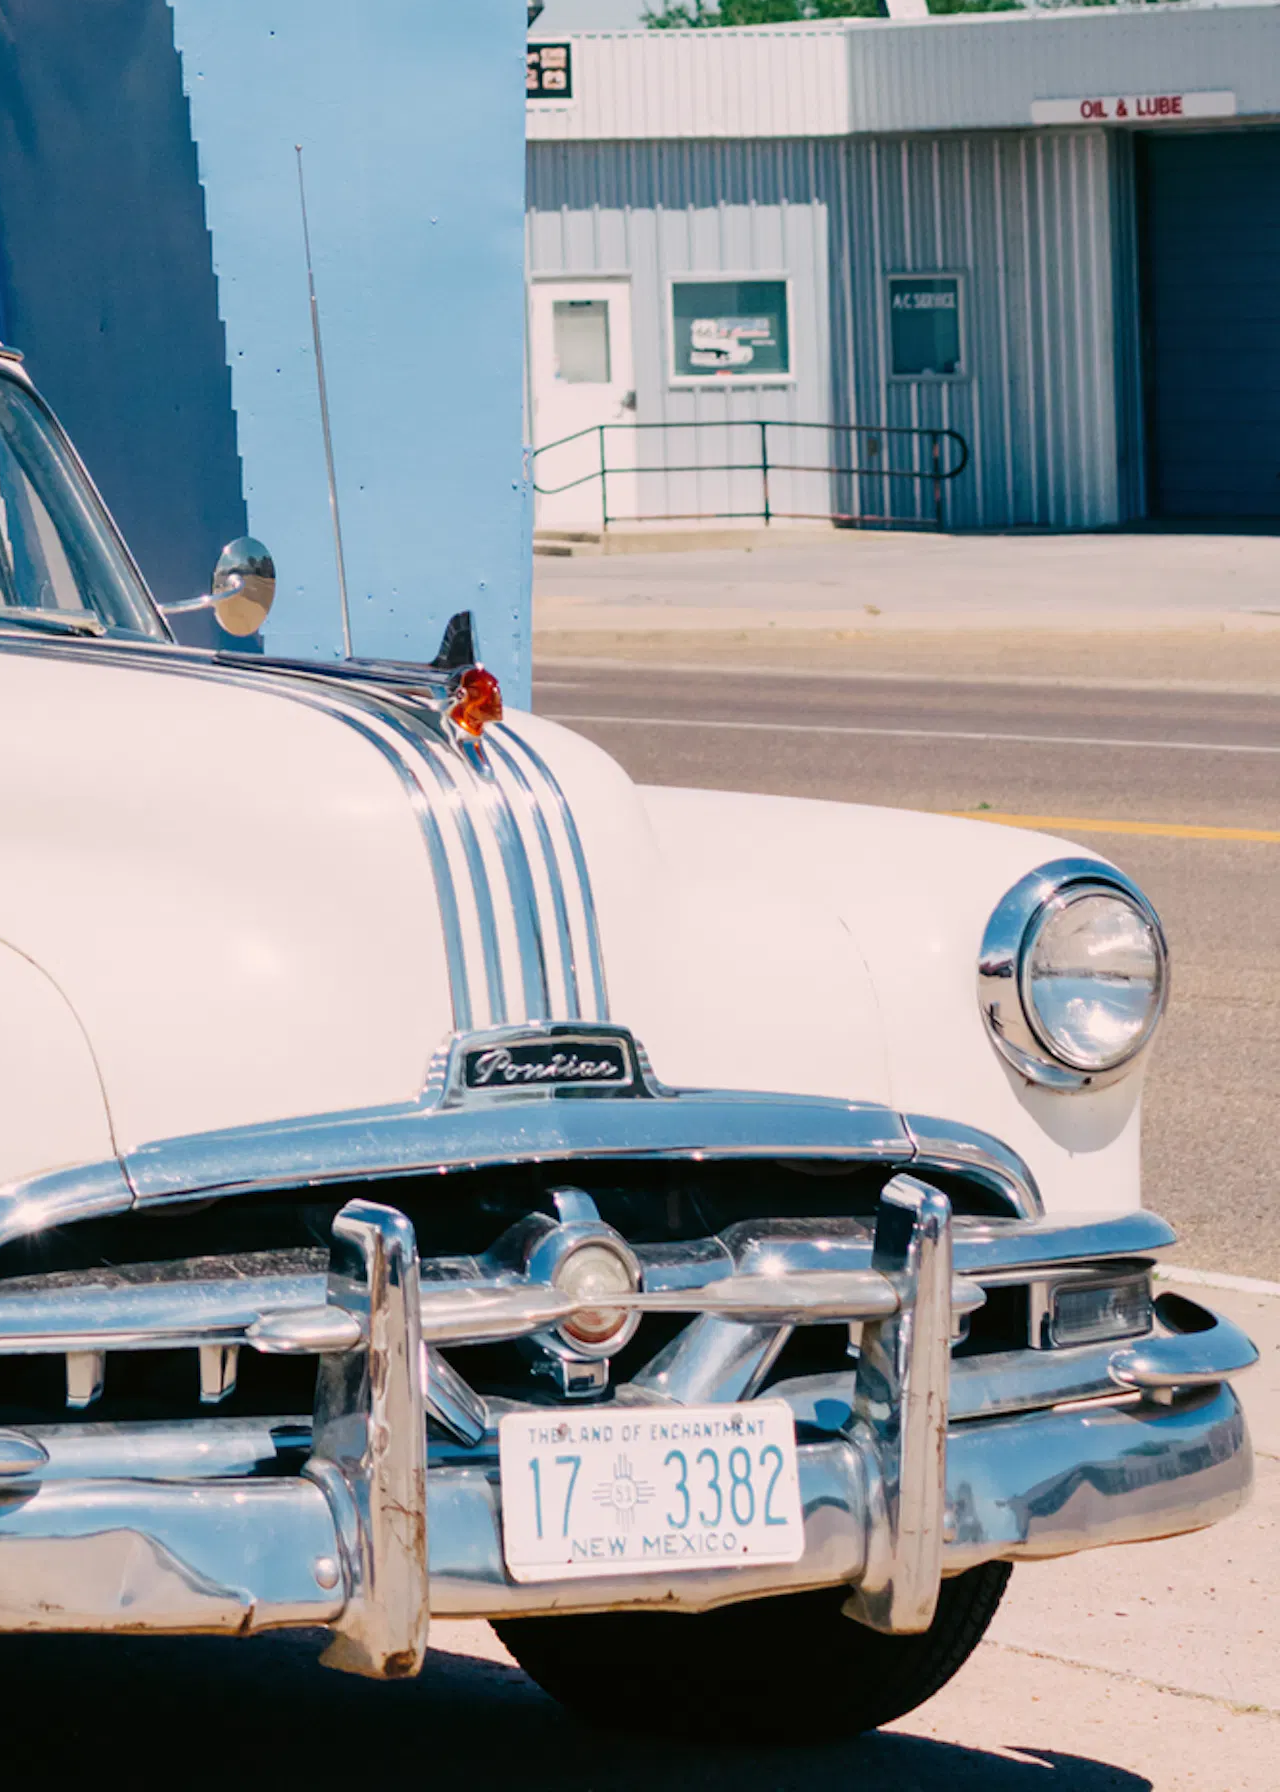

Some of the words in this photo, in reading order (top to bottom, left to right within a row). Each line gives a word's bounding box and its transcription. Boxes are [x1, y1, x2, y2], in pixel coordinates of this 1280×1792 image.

[1080, 99, 1108, 119] OIL
[1116, 98, 1128, 117] &
[1136, 95, 1184, 117] LUBE
[473, 1047, 619, 1085] Pontiac
[567, 1424, 613, 1443] LAND
[621, 1424, 642, 1442] OF
[650, 1419, 766, 1441] ENCHANTMENT
[529, 1455, 583, 1540] 17
[664, 1443, 789, 1529] 3382
[571, 1536, 628, 1558] NEW
[642, 1532, 738, 1555] MEXICO
